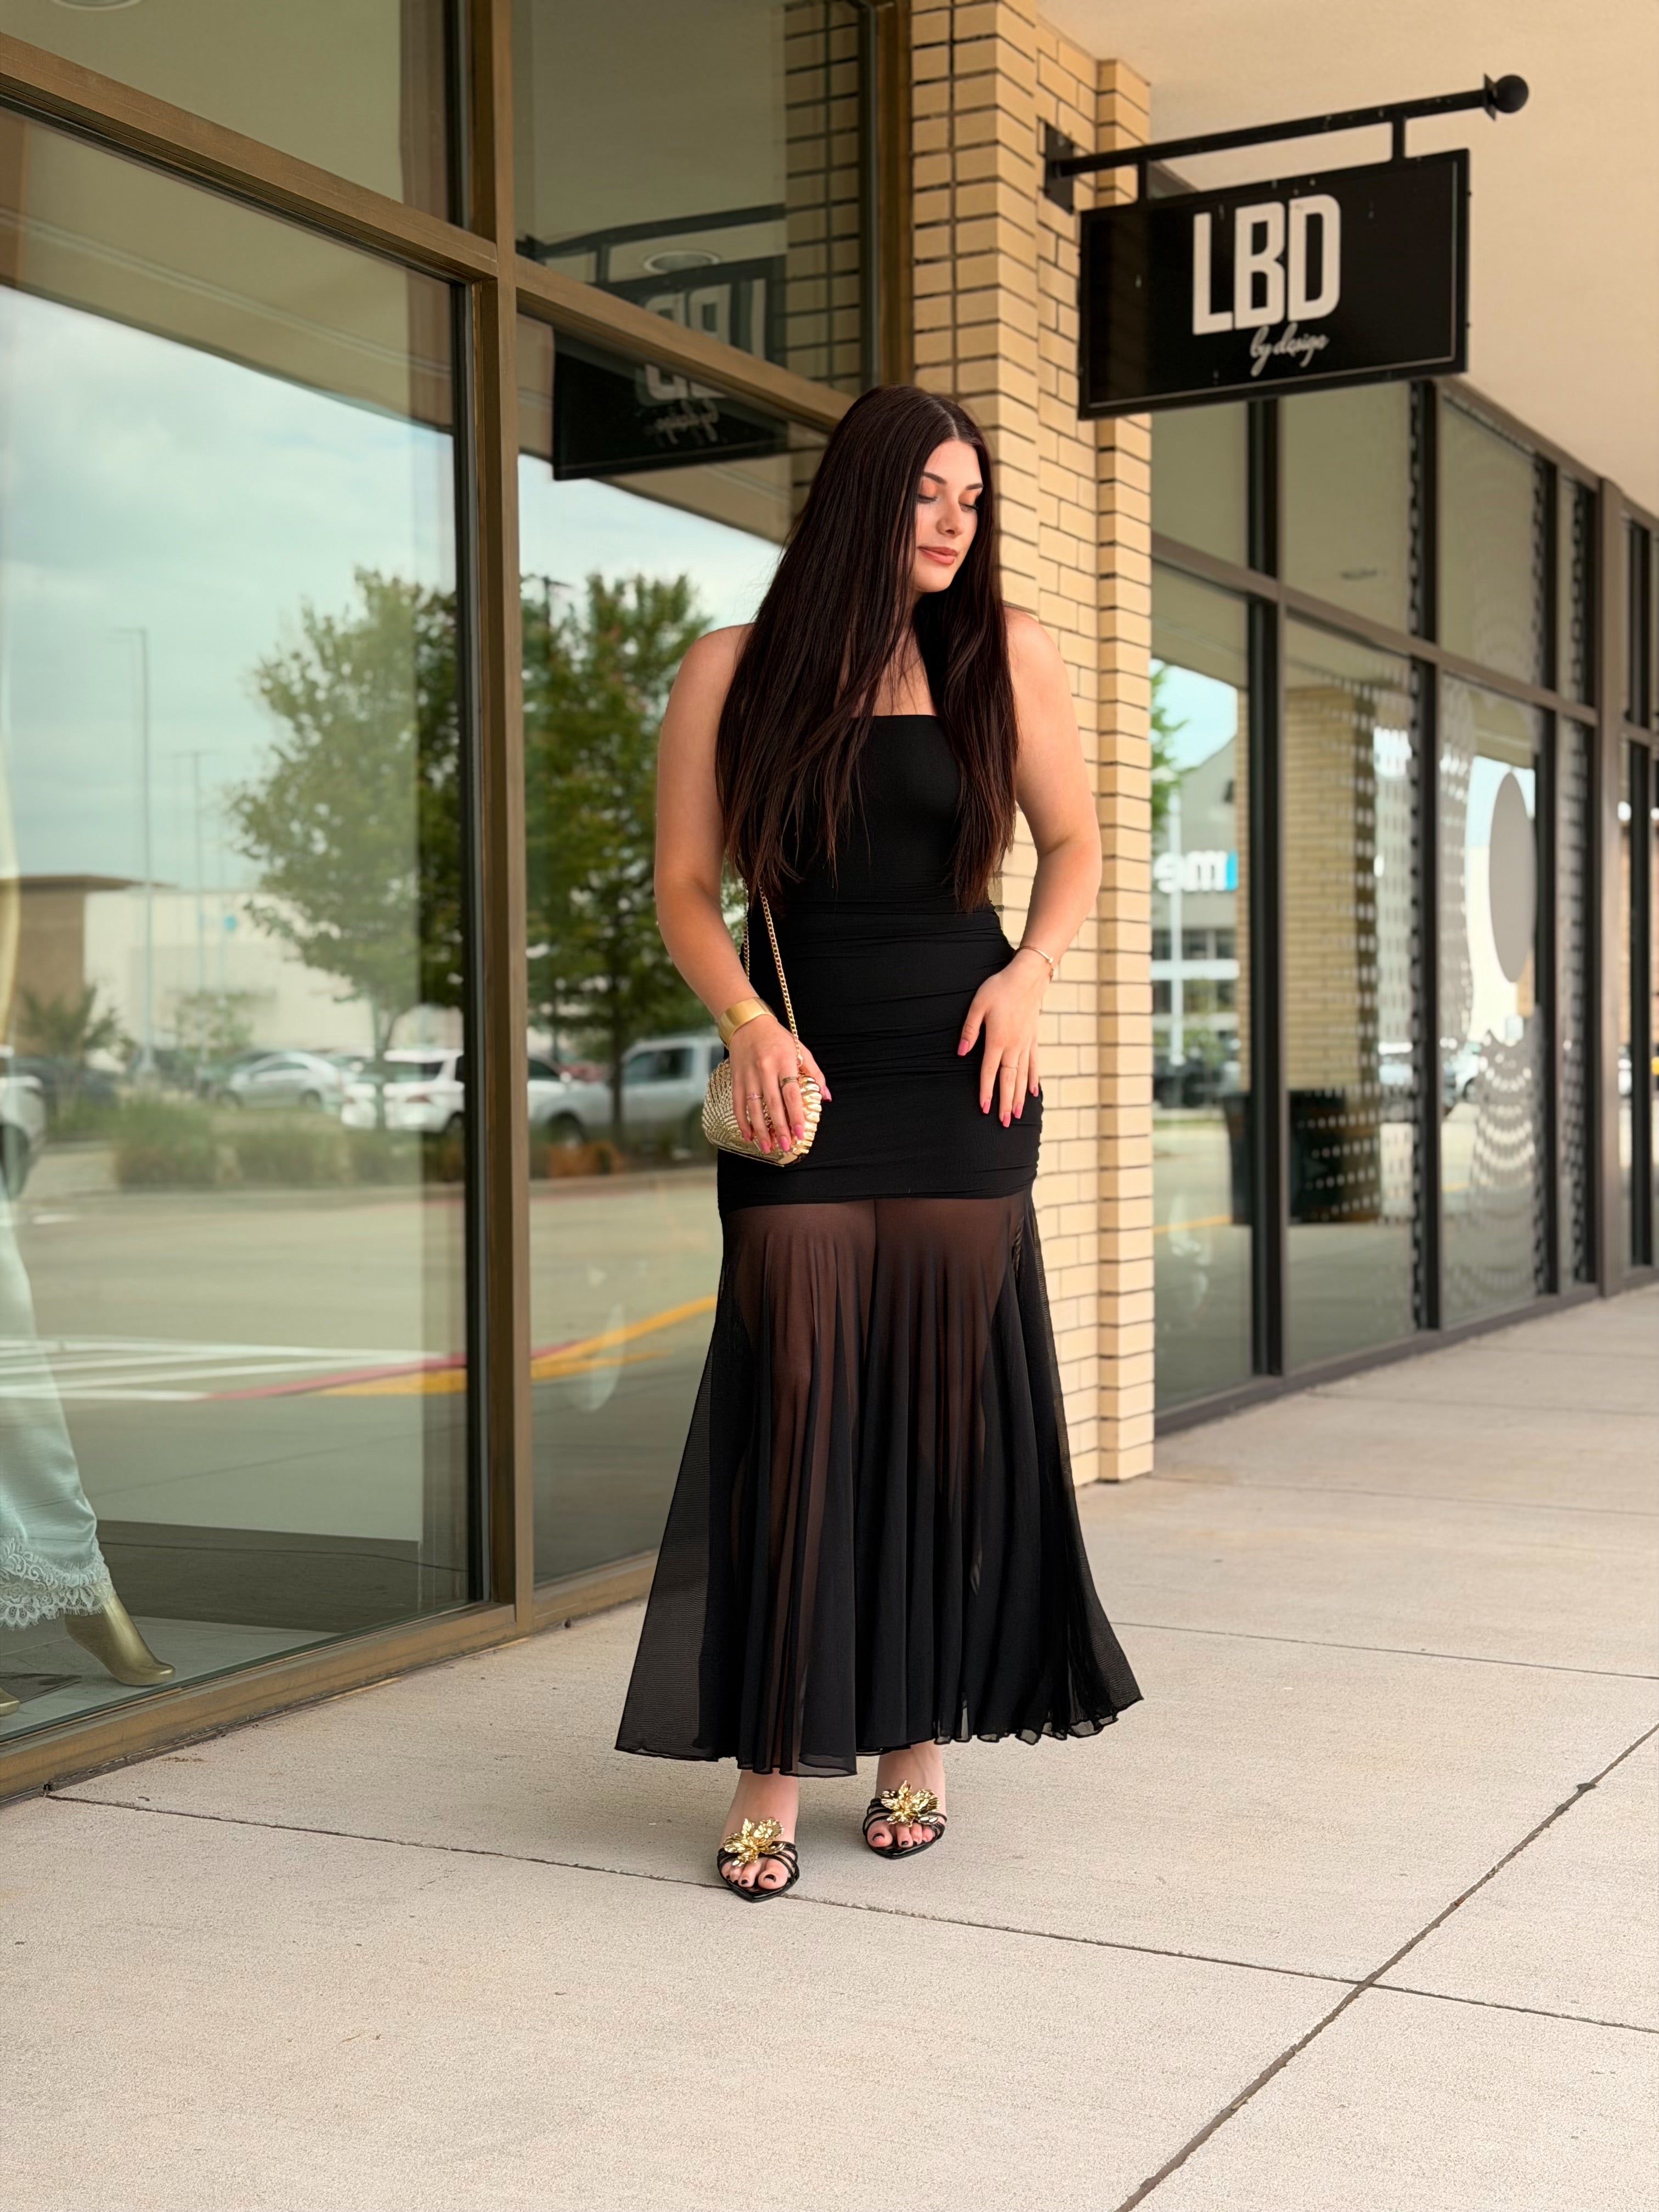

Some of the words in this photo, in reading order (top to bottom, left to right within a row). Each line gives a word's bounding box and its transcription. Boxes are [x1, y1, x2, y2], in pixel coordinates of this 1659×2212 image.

[1193, 194, 1341, 336] LBD
[1250, 325, 1273, 378] by
[1273, 322, 1330, 368] design
